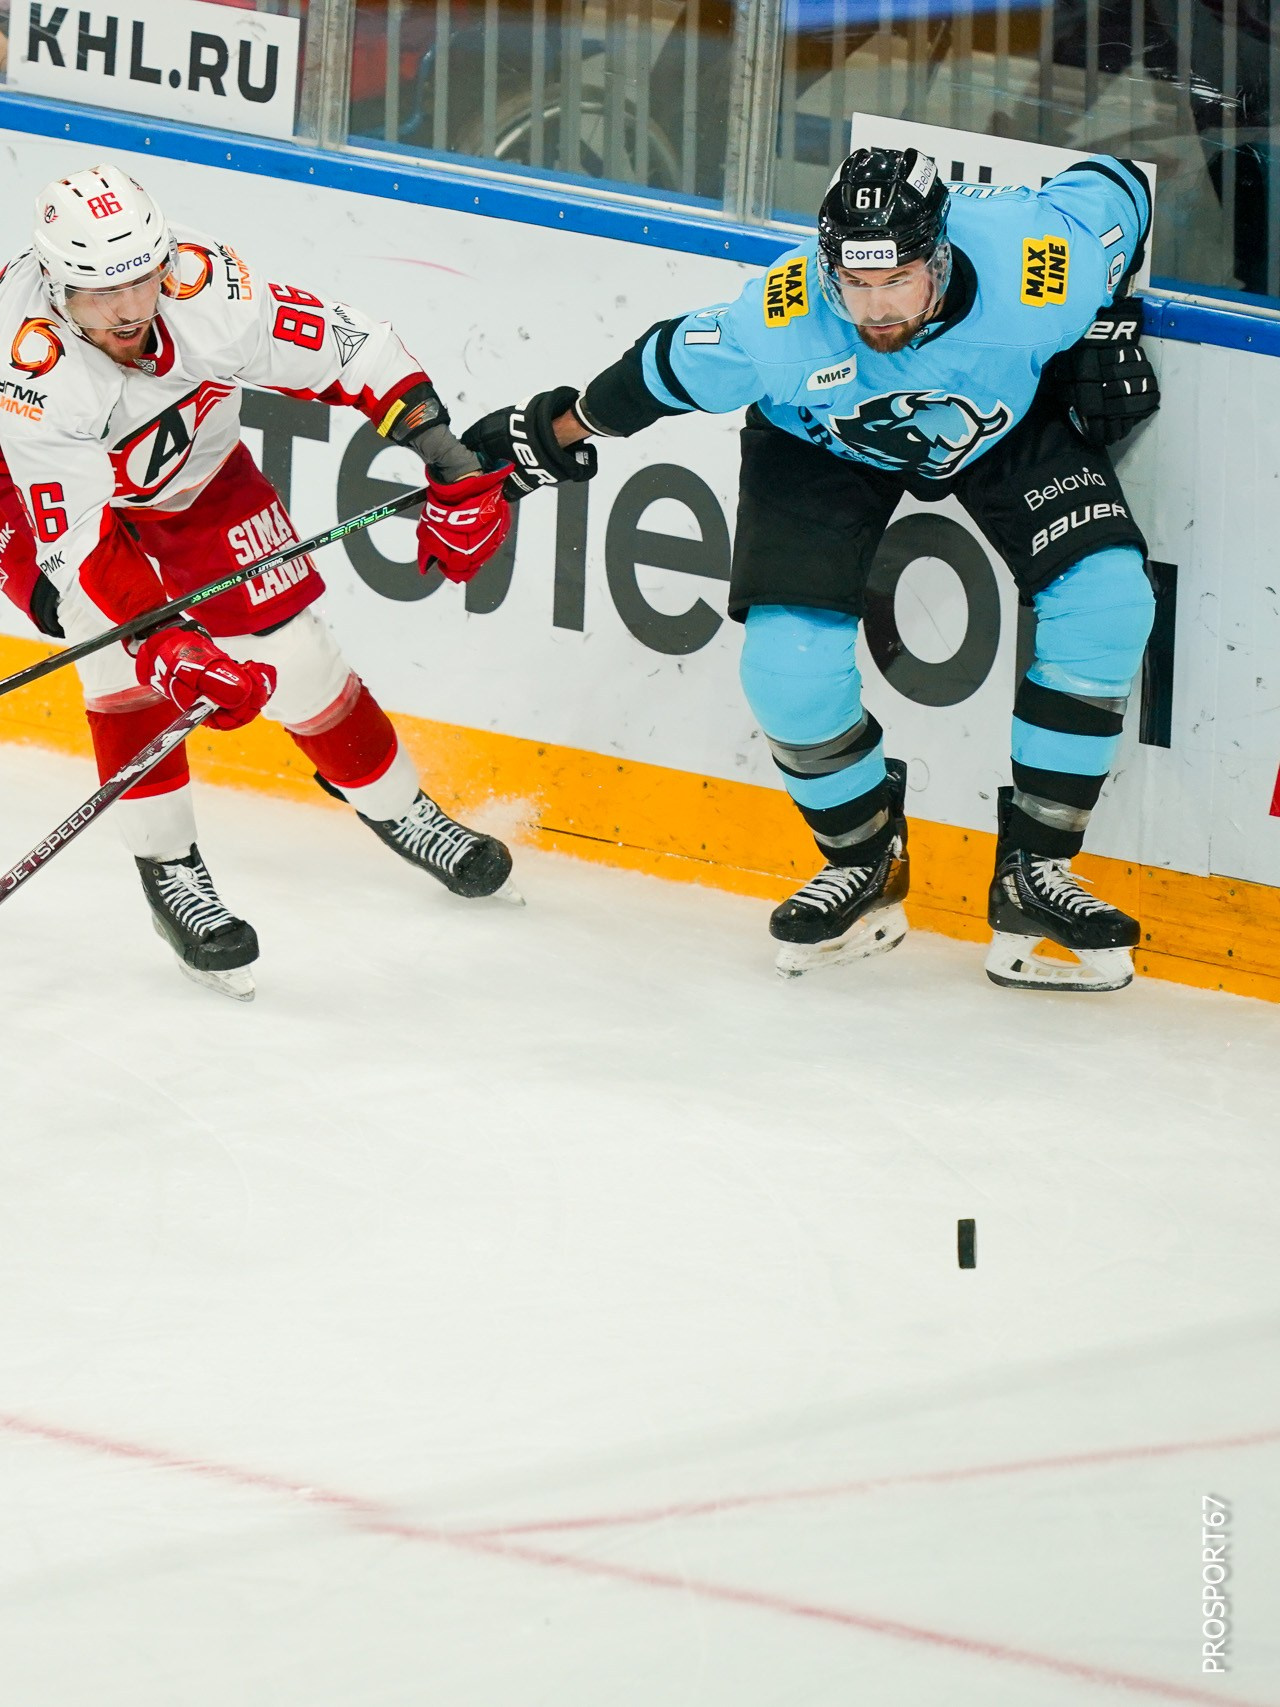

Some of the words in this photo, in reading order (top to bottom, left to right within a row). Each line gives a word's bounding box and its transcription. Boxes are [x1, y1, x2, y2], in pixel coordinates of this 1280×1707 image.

[27, 2, 280, 104] KHL.RU
[87, 192, 122, 219] 86
[856, 188, 882, 209] 61
[105, 252, 151, 276] согаз
[785, 263, 804, 309] MAX
[1026, 246, 1046, 298] MAX
[1047, 243, 1066, 295] LINE
[268, 283, 325, 351] 86
[767, 273, 784, 319] LINE
[1024, 467, 1106, 511] Belavia
[227, 501, 292, 566] SIMA
[5, 804, 95, 890] JETSPEED
